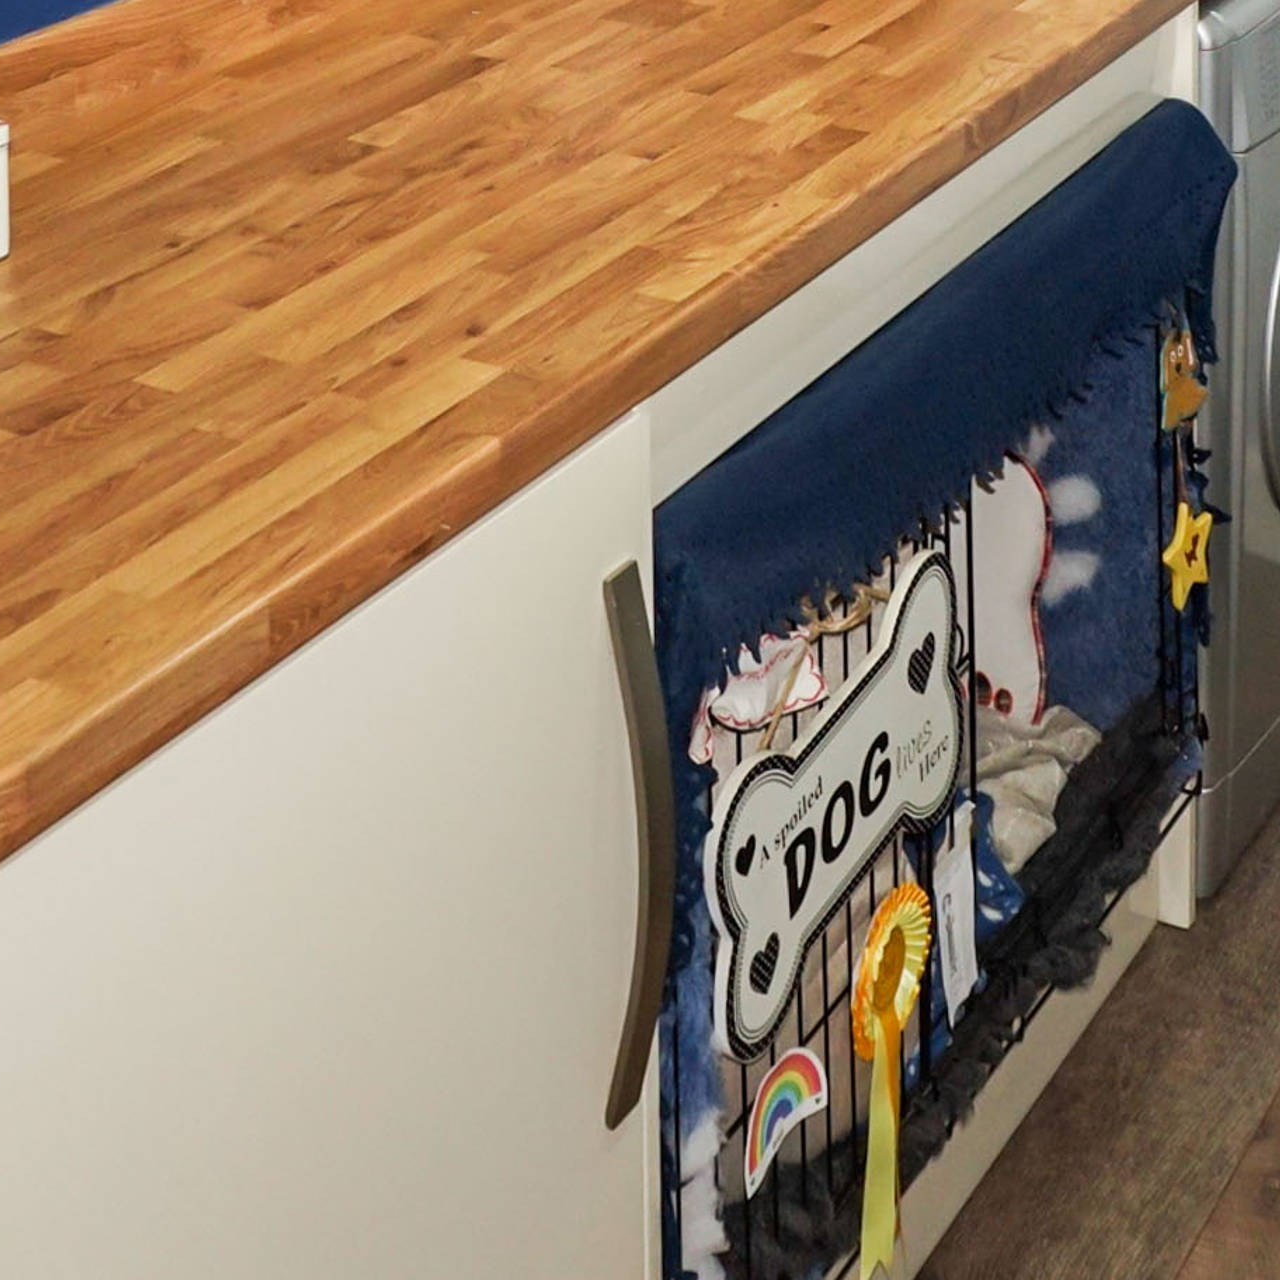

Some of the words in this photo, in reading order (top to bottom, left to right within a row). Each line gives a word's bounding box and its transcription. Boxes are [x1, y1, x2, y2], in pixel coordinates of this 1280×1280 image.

[895, 719, 934, 779] lives
[919, 734, 950, 783] Here
[760, 843, 771, 869] A
[773, 775, 824, 850] spoiled
[784, 730, 892, 921] DOG
